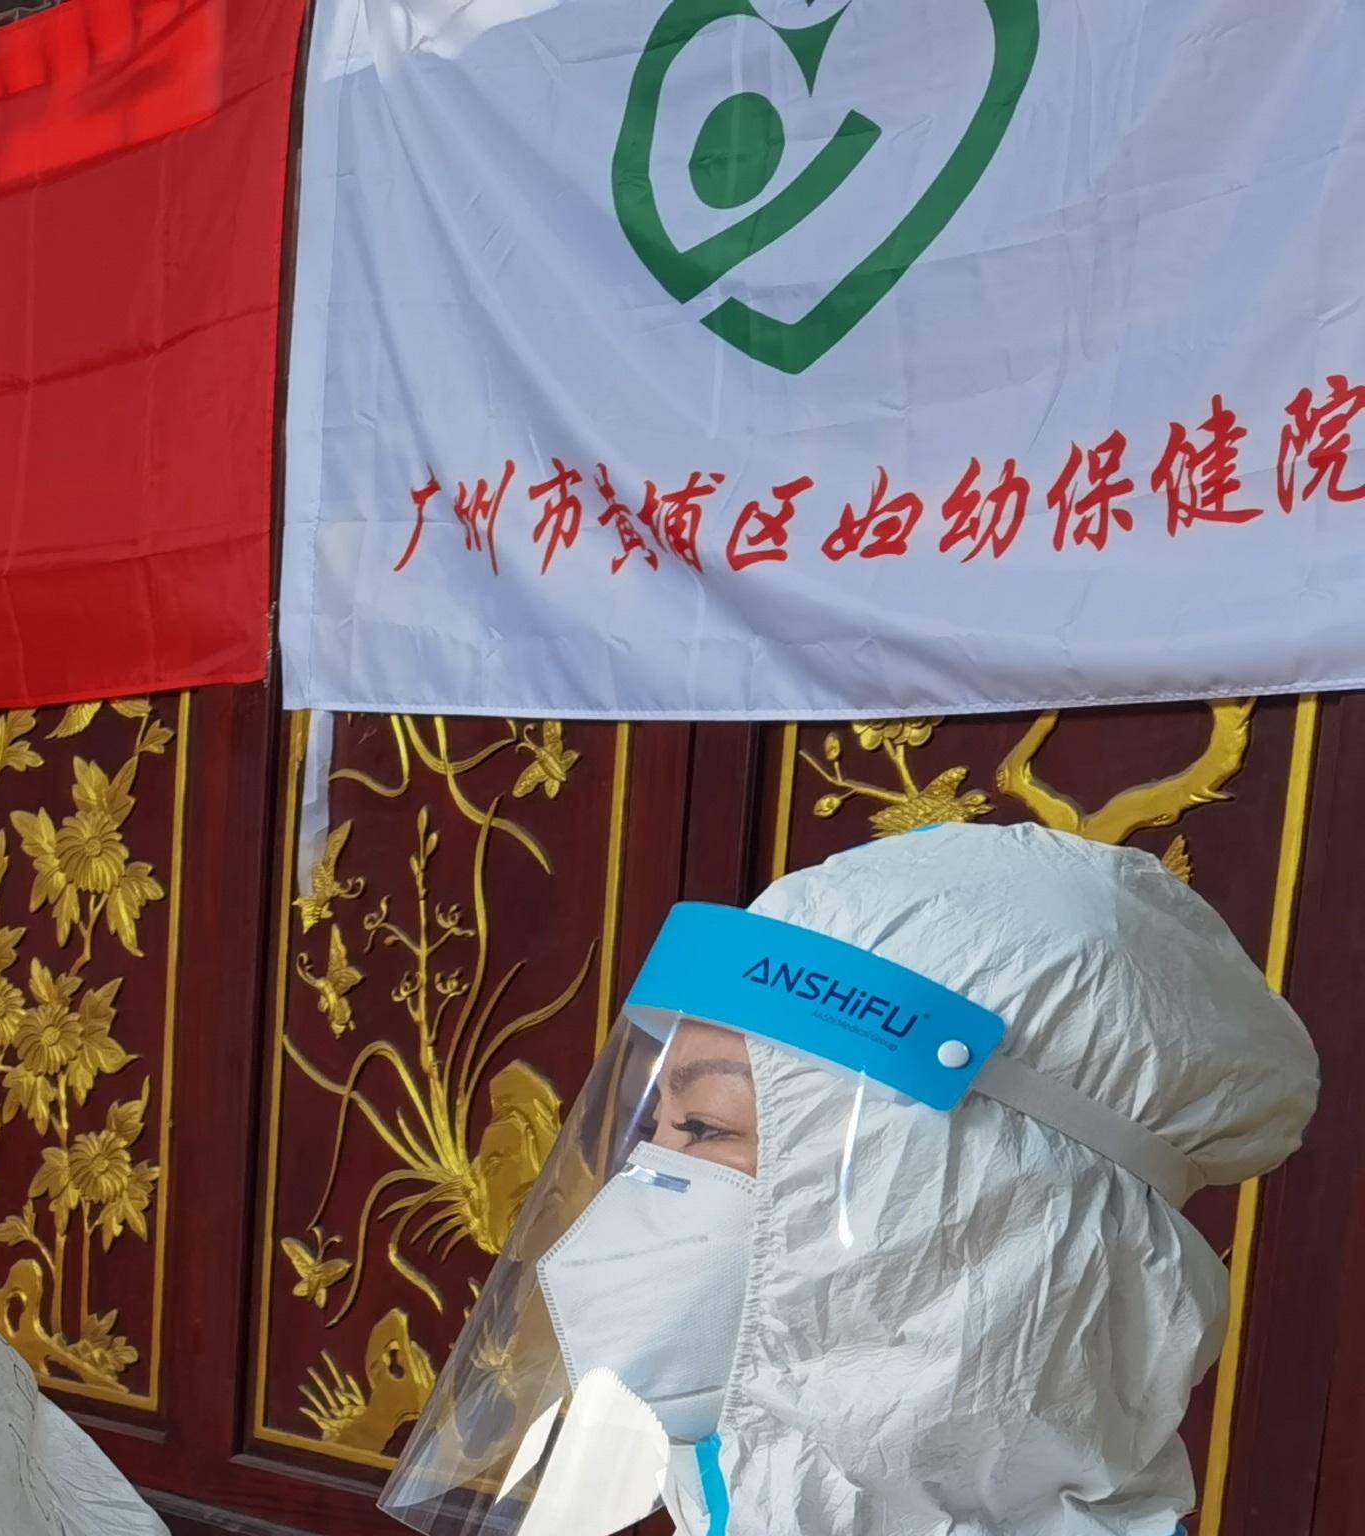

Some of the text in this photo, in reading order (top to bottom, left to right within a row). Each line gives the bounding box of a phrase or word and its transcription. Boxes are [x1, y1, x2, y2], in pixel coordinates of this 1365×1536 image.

[394, 374, 1365, 577] 广州市黄埔区妇幼保健院
